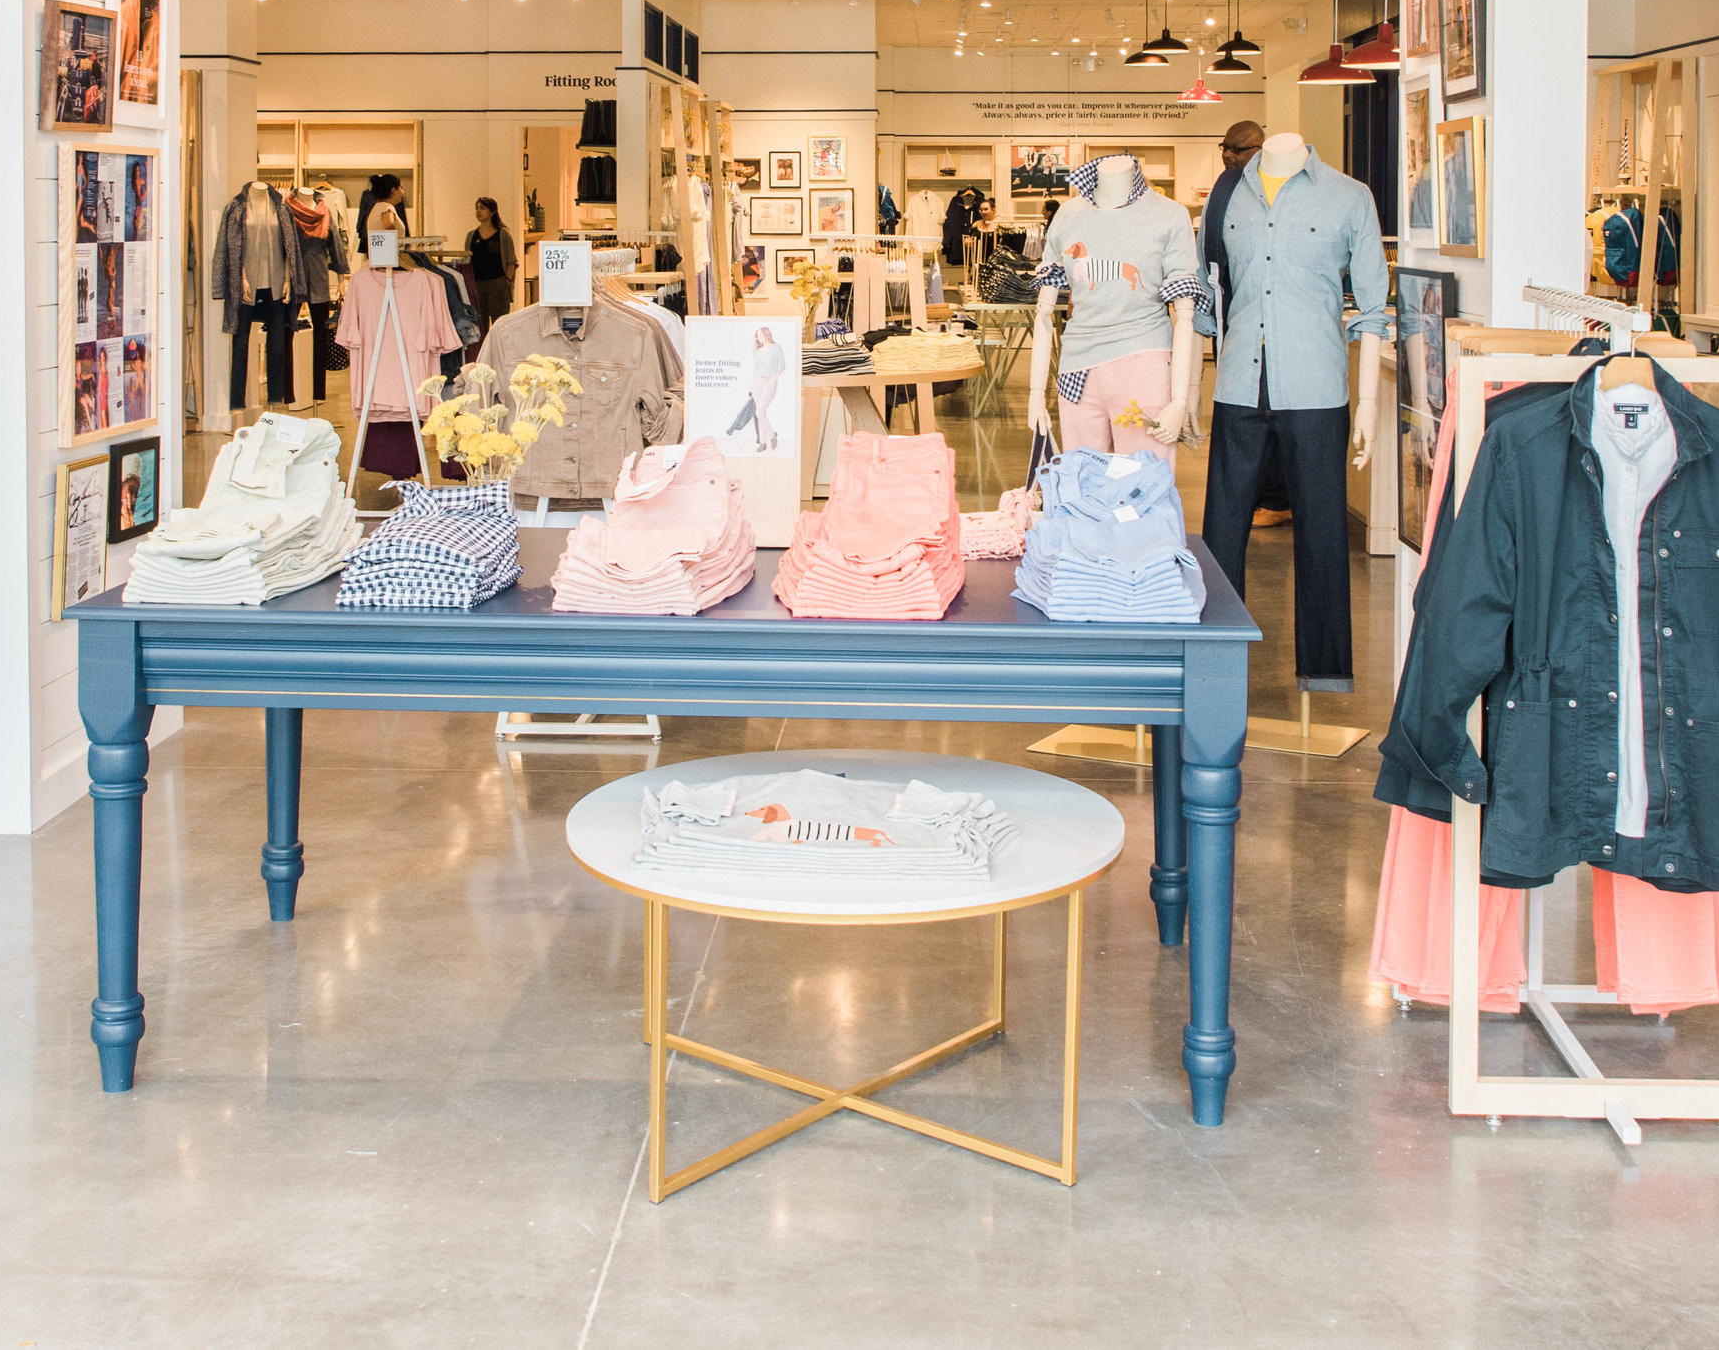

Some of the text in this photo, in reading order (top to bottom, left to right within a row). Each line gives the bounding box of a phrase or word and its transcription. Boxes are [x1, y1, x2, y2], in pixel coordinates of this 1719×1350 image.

[545, 74, 591, 90] Fitting
[1016, 102, 1034, 110] good
[1165, 102, 1198, 110] possible.
[1046, 112, 1066, 120] price
[545, 250, 569, 259] 25%
